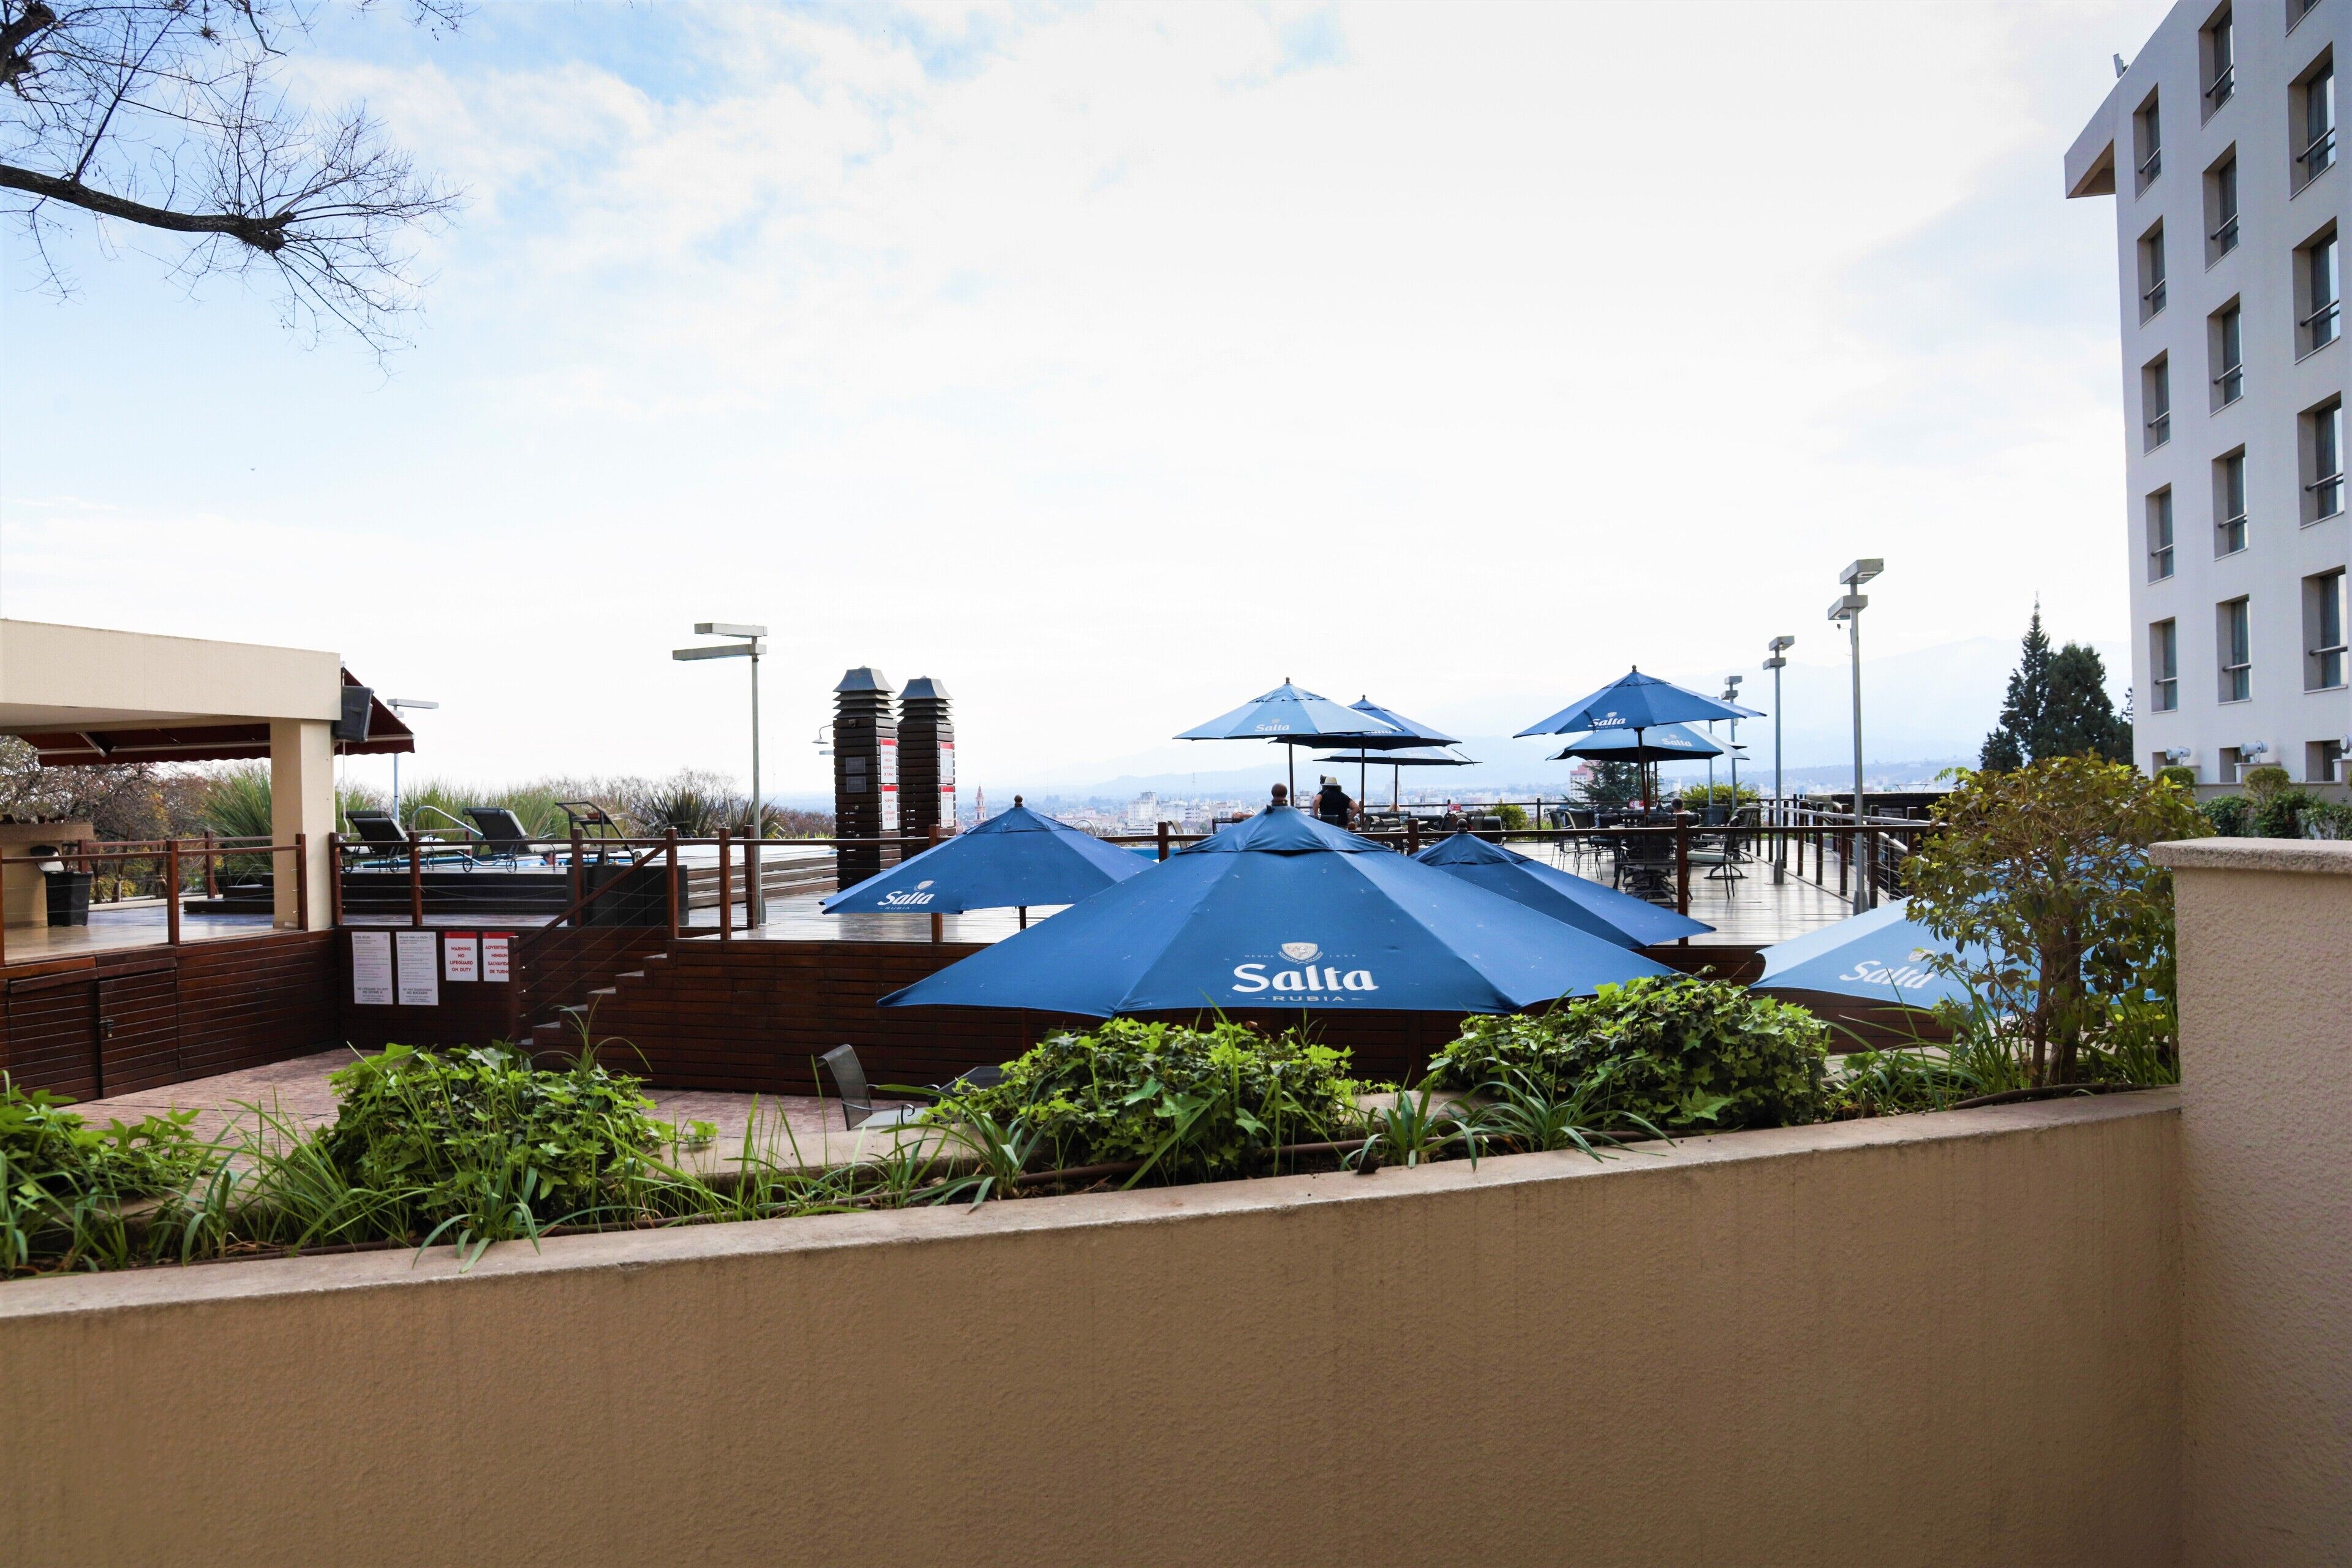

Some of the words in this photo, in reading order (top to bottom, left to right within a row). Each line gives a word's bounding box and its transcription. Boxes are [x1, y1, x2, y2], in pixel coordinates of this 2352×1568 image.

[1588, 718, 1626, 727] Salta
[1662, 738, 1693, 747] Salta
[877, 891, 935, 905] Salta
[1232, 963, 1379, 993] Salta
[1839, 960, 1936, 989] Salta
